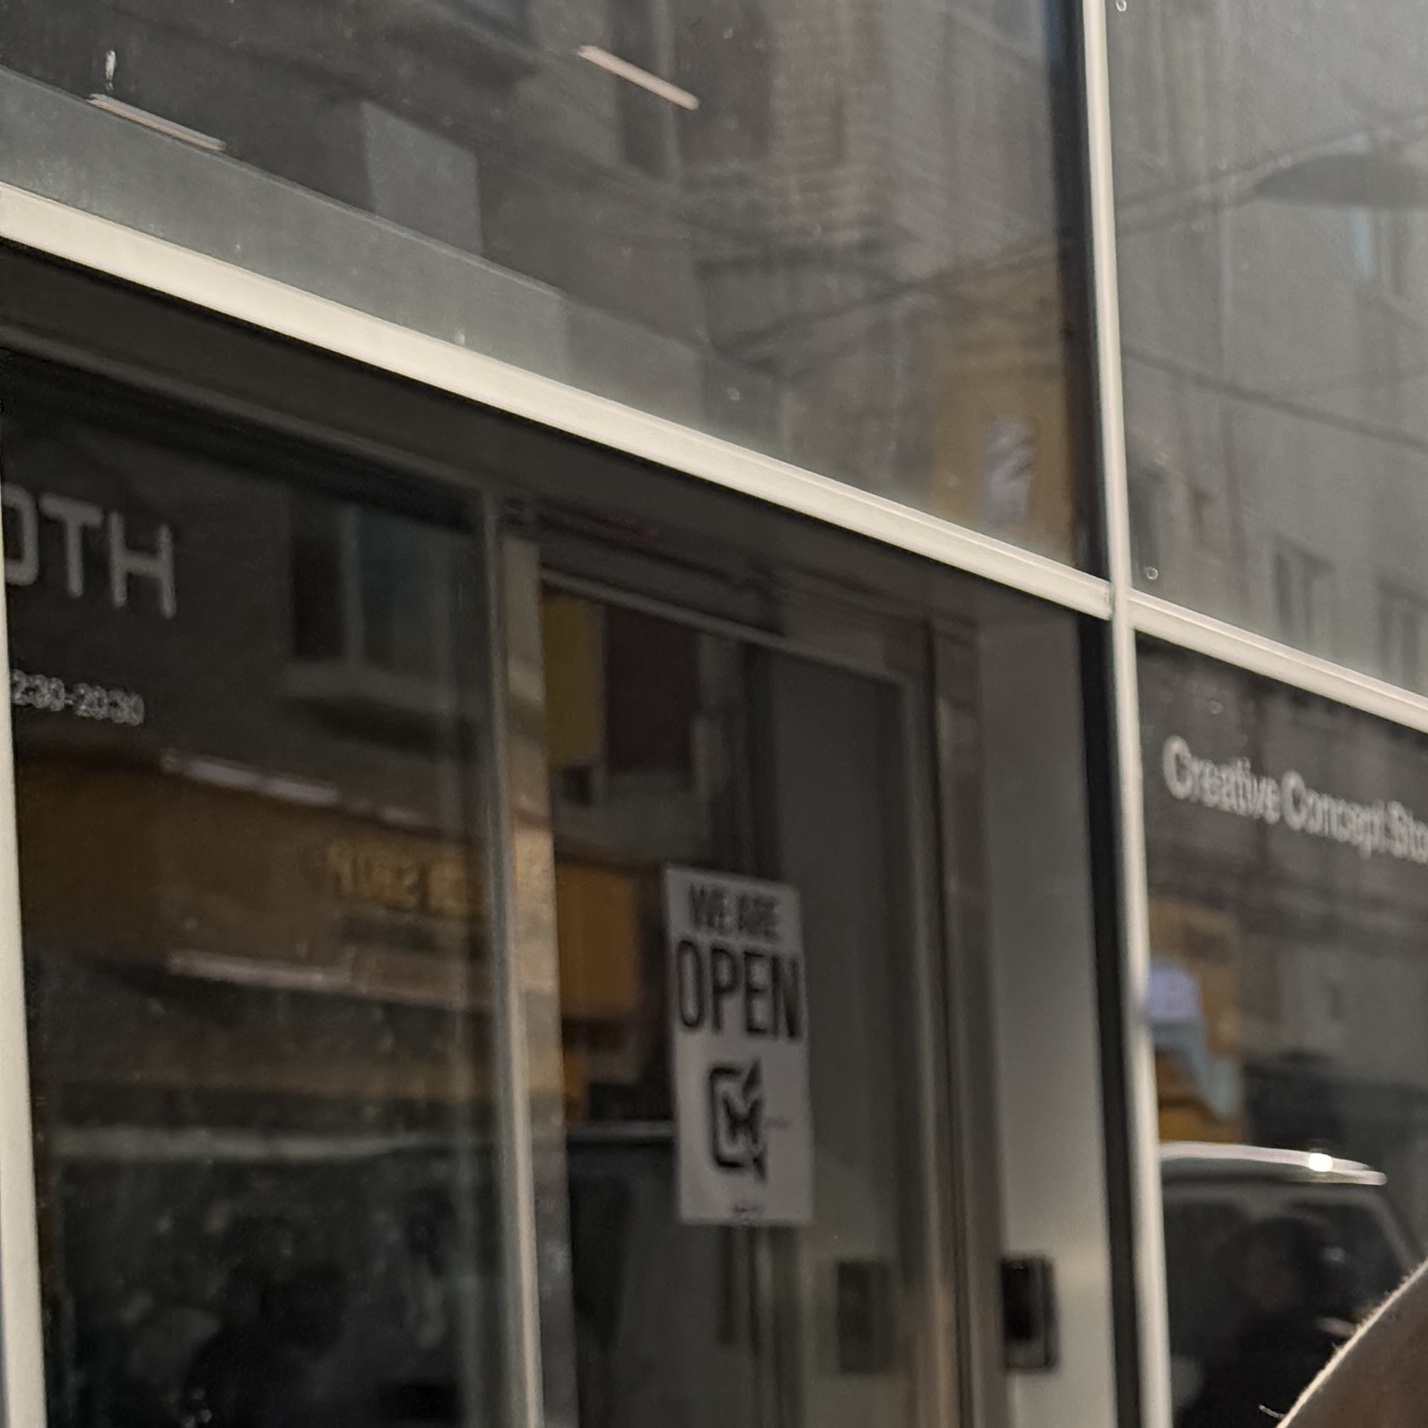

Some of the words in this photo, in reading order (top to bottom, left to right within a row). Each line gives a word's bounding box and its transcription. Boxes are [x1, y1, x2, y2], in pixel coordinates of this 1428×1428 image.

[1162, 734, 1281, 825] Creative
[1281, 769, 1386, 860] Concept
[676, 938, 804, 1041] OPEN
